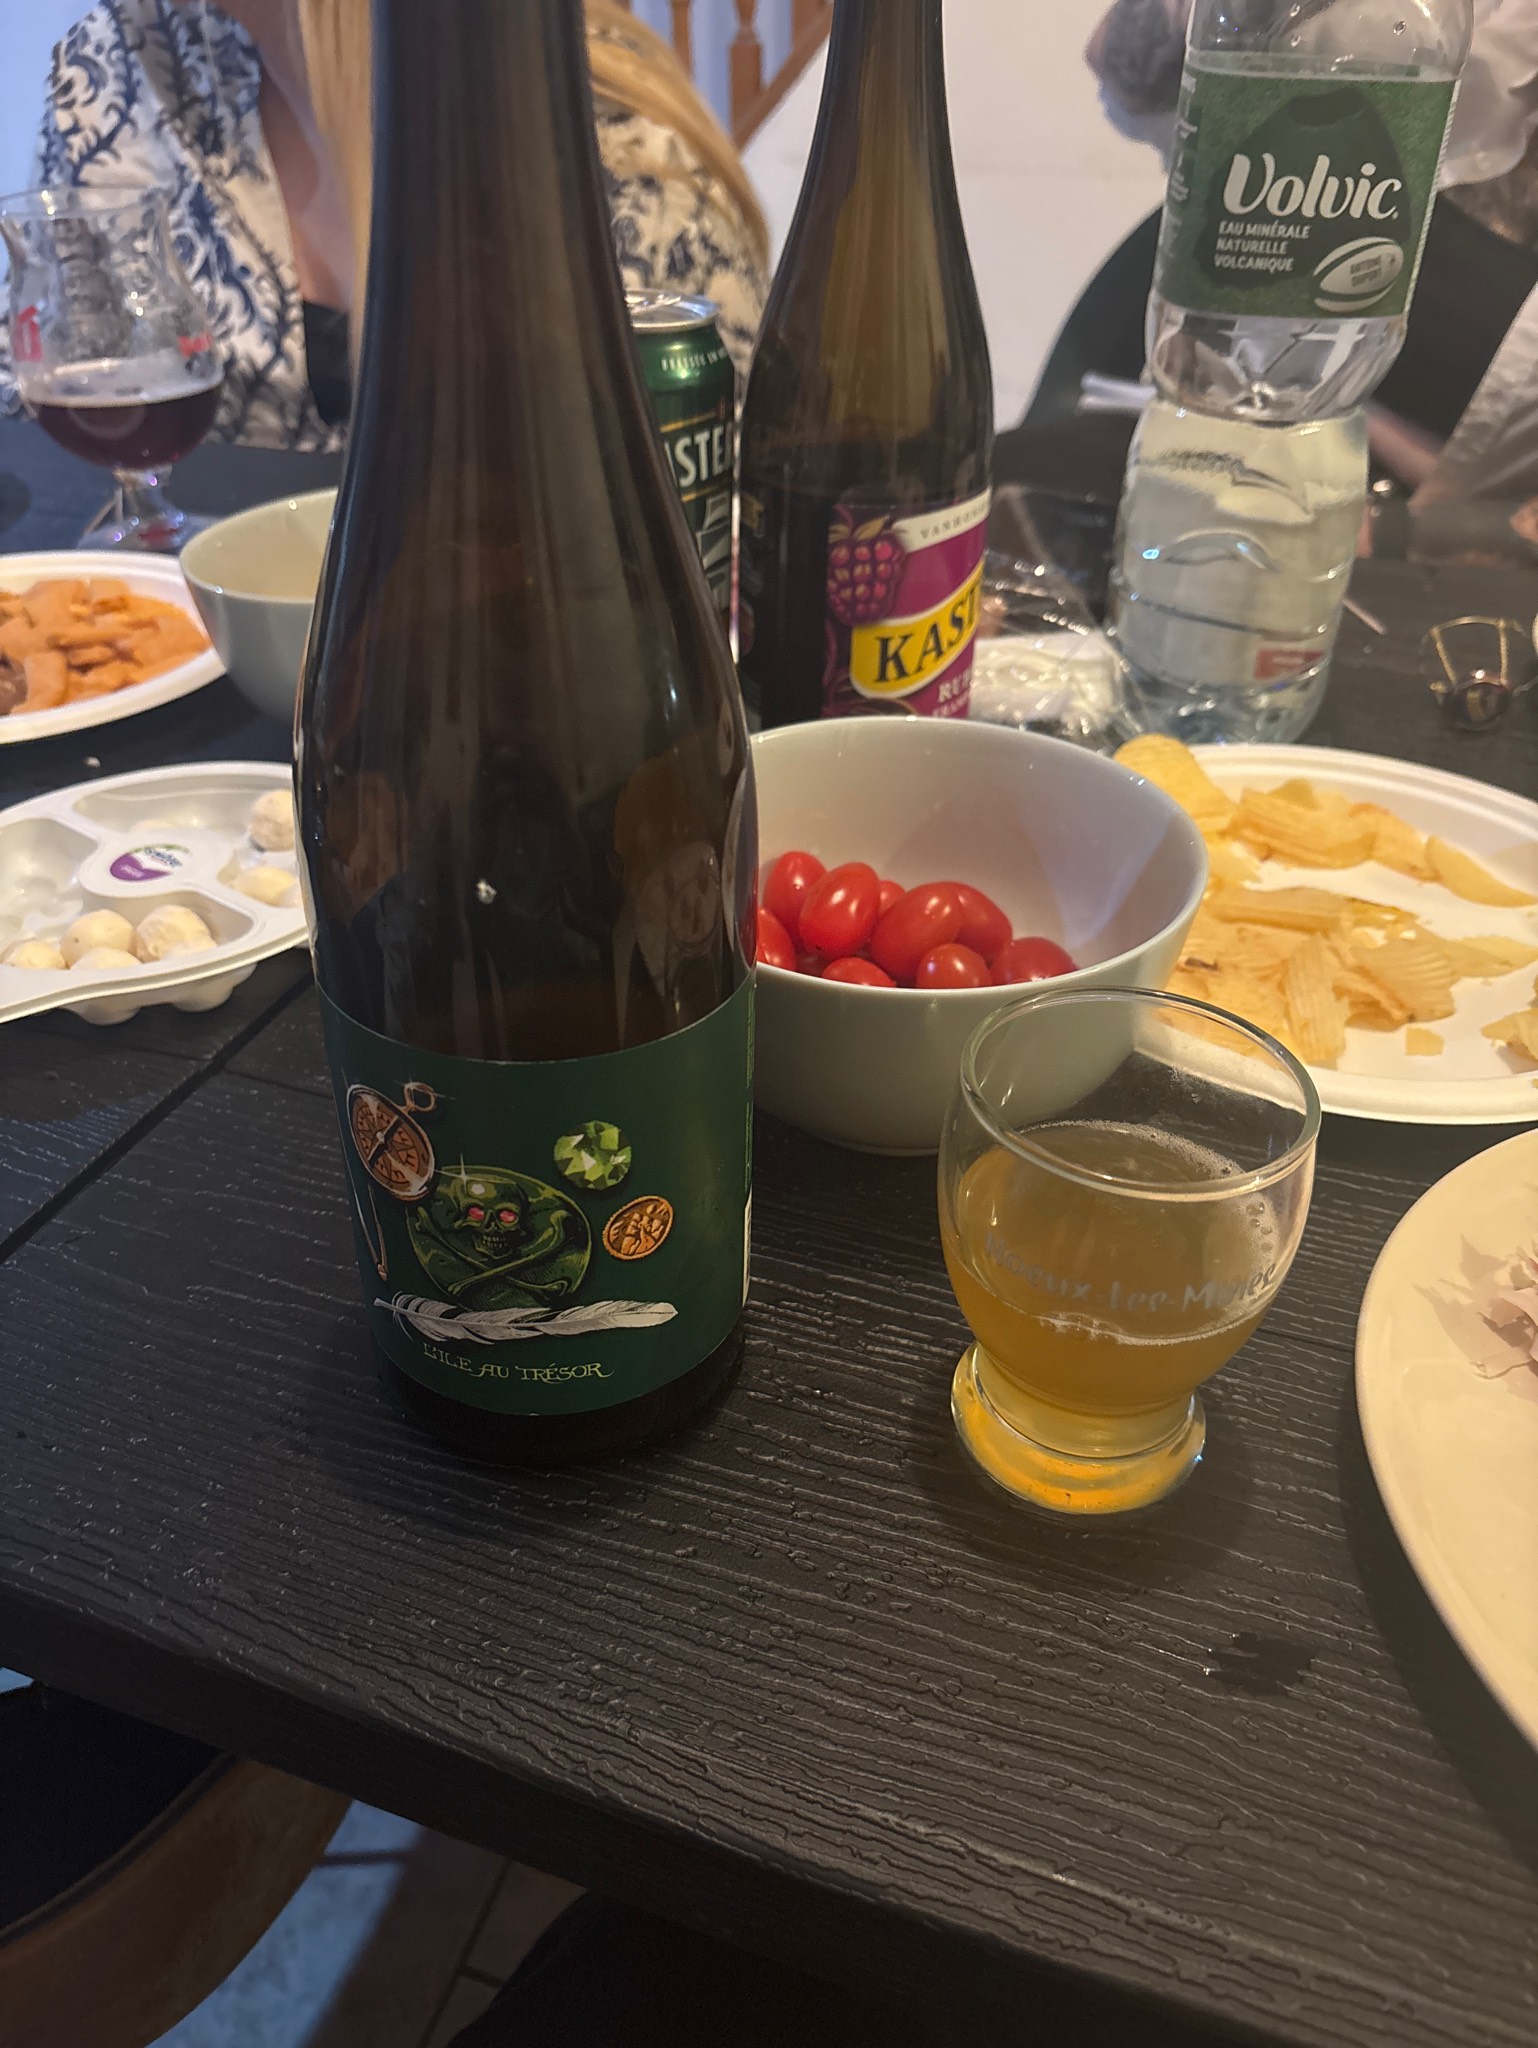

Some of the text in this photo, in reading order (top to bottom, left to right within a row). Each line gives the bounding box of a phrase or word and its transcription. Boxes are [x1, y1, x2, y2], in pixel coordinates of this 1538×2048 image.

[1223, 153, 1402, 219] Volvic
[1219, 219, 1311, 239] EAU MINÉRALE
[1216, 237, 1288, 254] NATURELLE
[1213, 254, 1294, 274] VOLCANIQUE
[470, 1363, 510, 1378] AU
[515, 1362, 615, 1384] TRÉSOR
